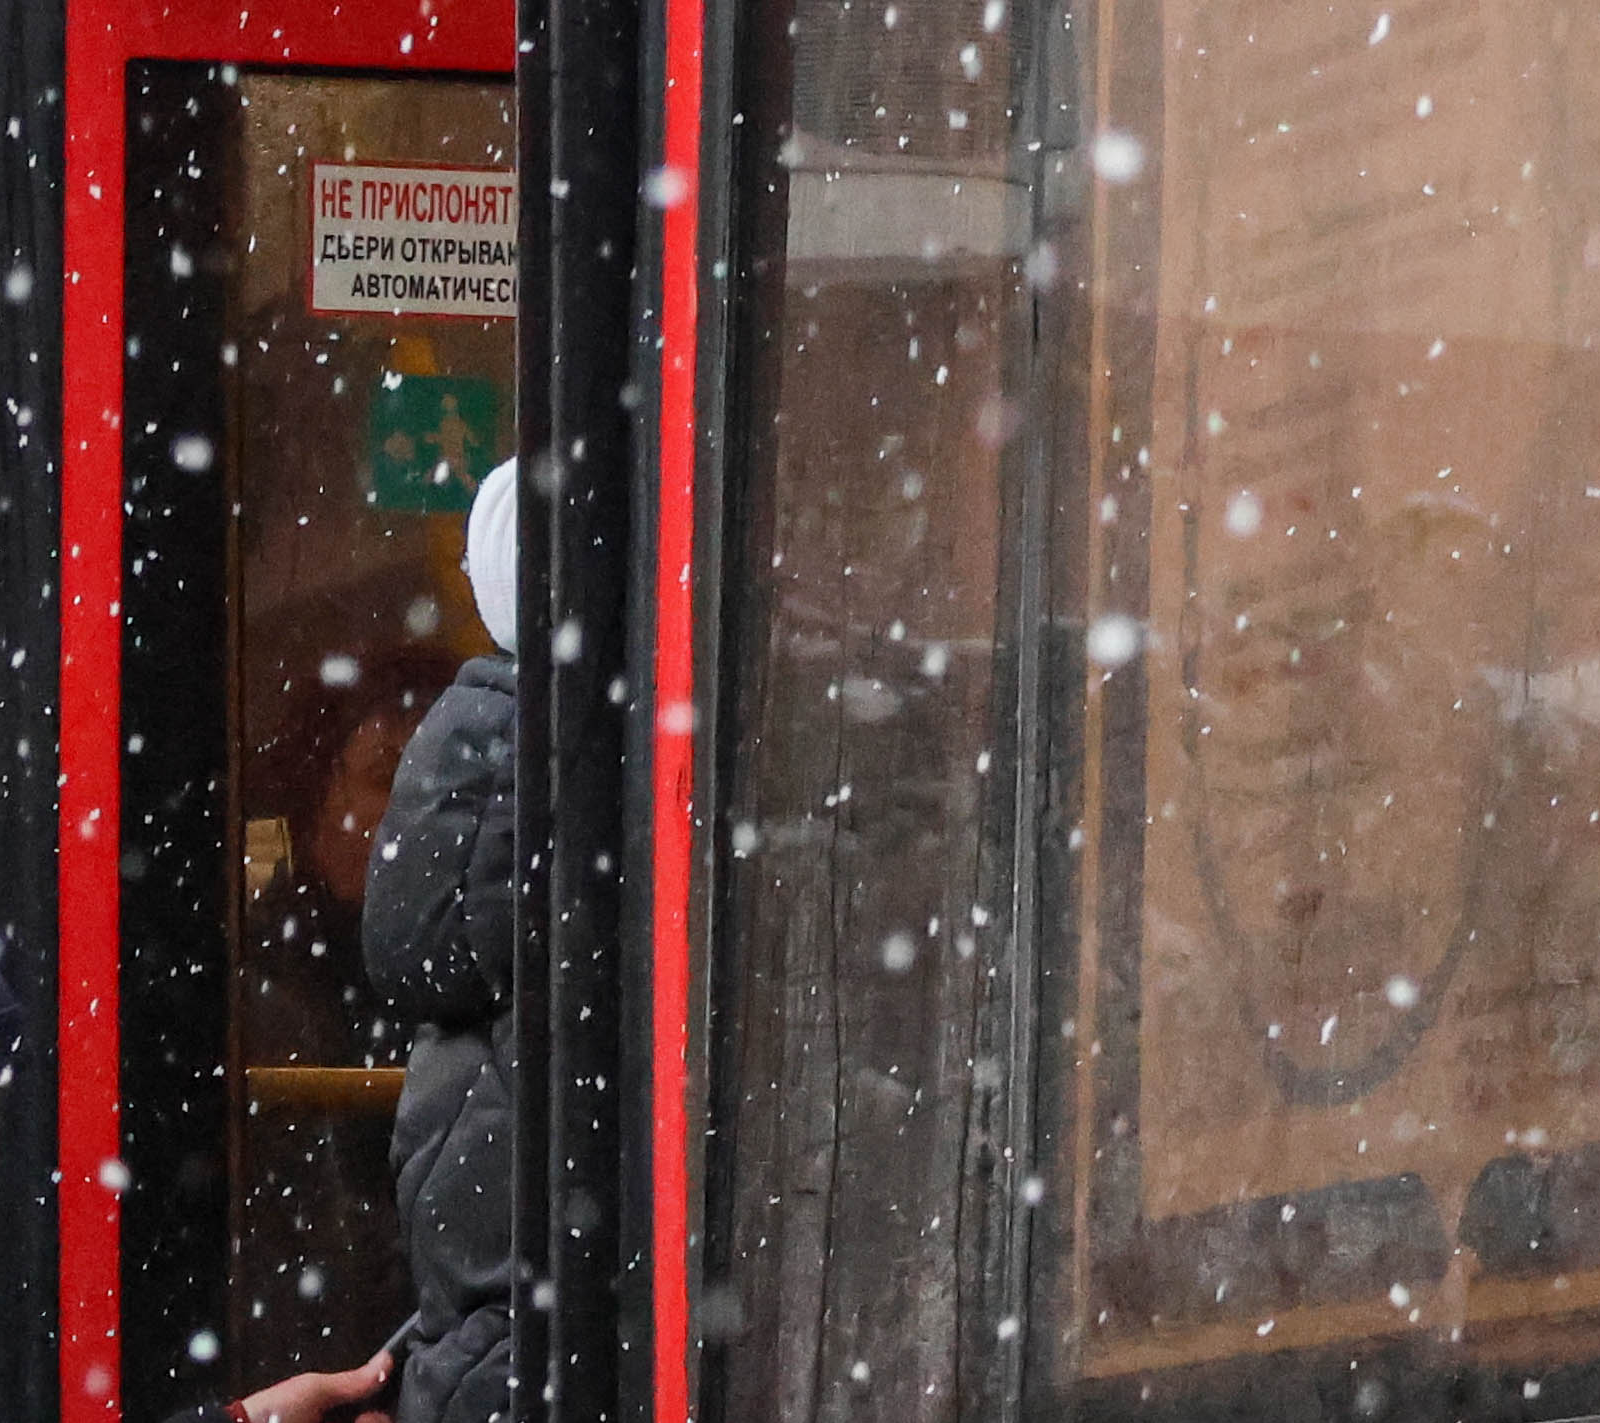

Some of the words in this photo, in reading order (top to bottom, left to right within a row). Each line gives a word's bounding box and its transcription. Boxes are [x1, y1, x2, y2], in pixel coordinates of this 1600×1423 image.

[321, 179, 353, 219] НЕ
[361, 180, 513, 224] ПРИСЛОНЯТ
[351, 273, 517, 303] АВТОМАТИЧЕС
